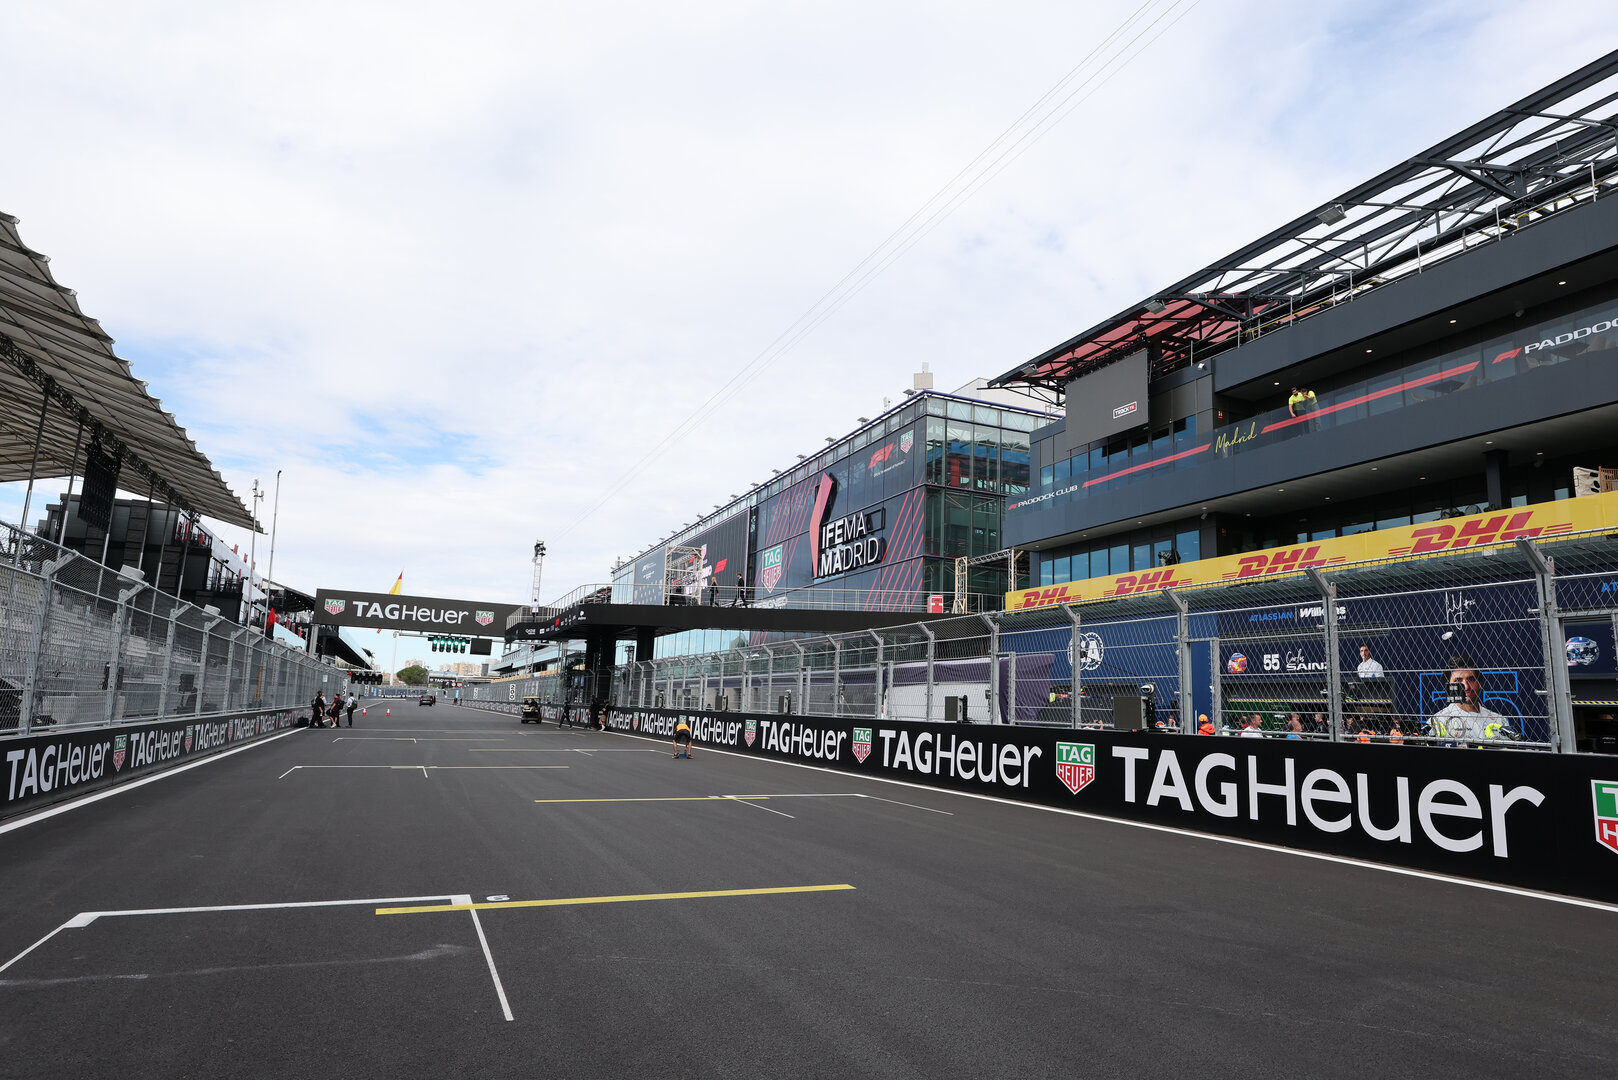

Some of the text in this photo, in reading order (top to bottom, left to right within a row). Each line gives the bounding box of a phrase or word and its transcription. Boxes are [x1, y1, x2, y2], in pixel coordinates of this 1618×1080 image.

[1215, 421, 1257, 454] Madrid
[1018, 491, 1055, 508] PADDOCK
[1056, 484, 1078, 497] CLUB
[822, 511, 867, 549] IFEMA
[1410, 511, 1545, 555] DHL
[764, 548, 781, 567] TAG
[821, 537, 879, 577] MADRID
[1237, 545, 1328, 578] DHL
[1114, 569, 1179, 596] DHL
[327, 599, 344, 607] TAG
[1022, 586, 1071, 609] DHL
[1249, 611, 1293, 622] ATLASSIAN
[1263, 653, 1280, 671] 55
[115, 736, 126, 750] TAG
[855, 730, 870, 742] TAG
[853, 743, 871, 761] HEUER
[1059, 744, 1092, 763] TAG
[1058, 765, 1094, 790] HEUER
